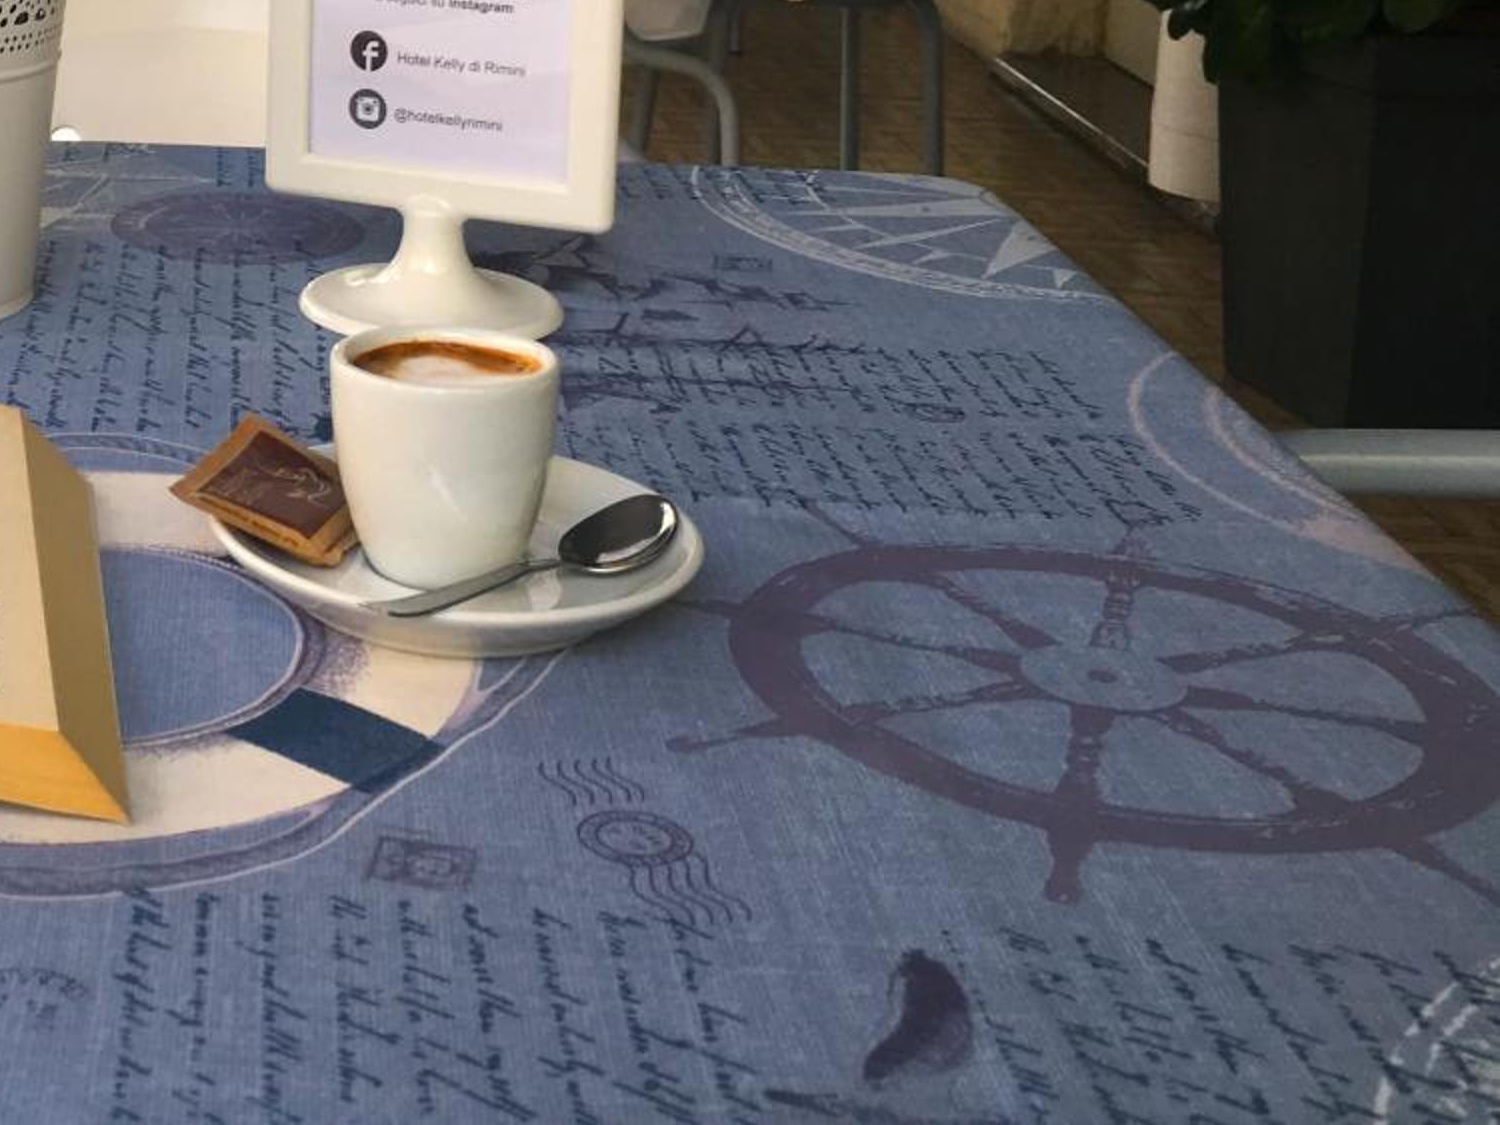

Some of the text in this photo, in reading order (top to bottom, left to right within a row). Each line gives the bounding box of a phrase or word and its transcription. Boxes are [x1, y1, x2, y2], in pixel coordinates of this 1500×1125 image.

[397, 51, 526, 77] Hotel Kelly di Rimini
